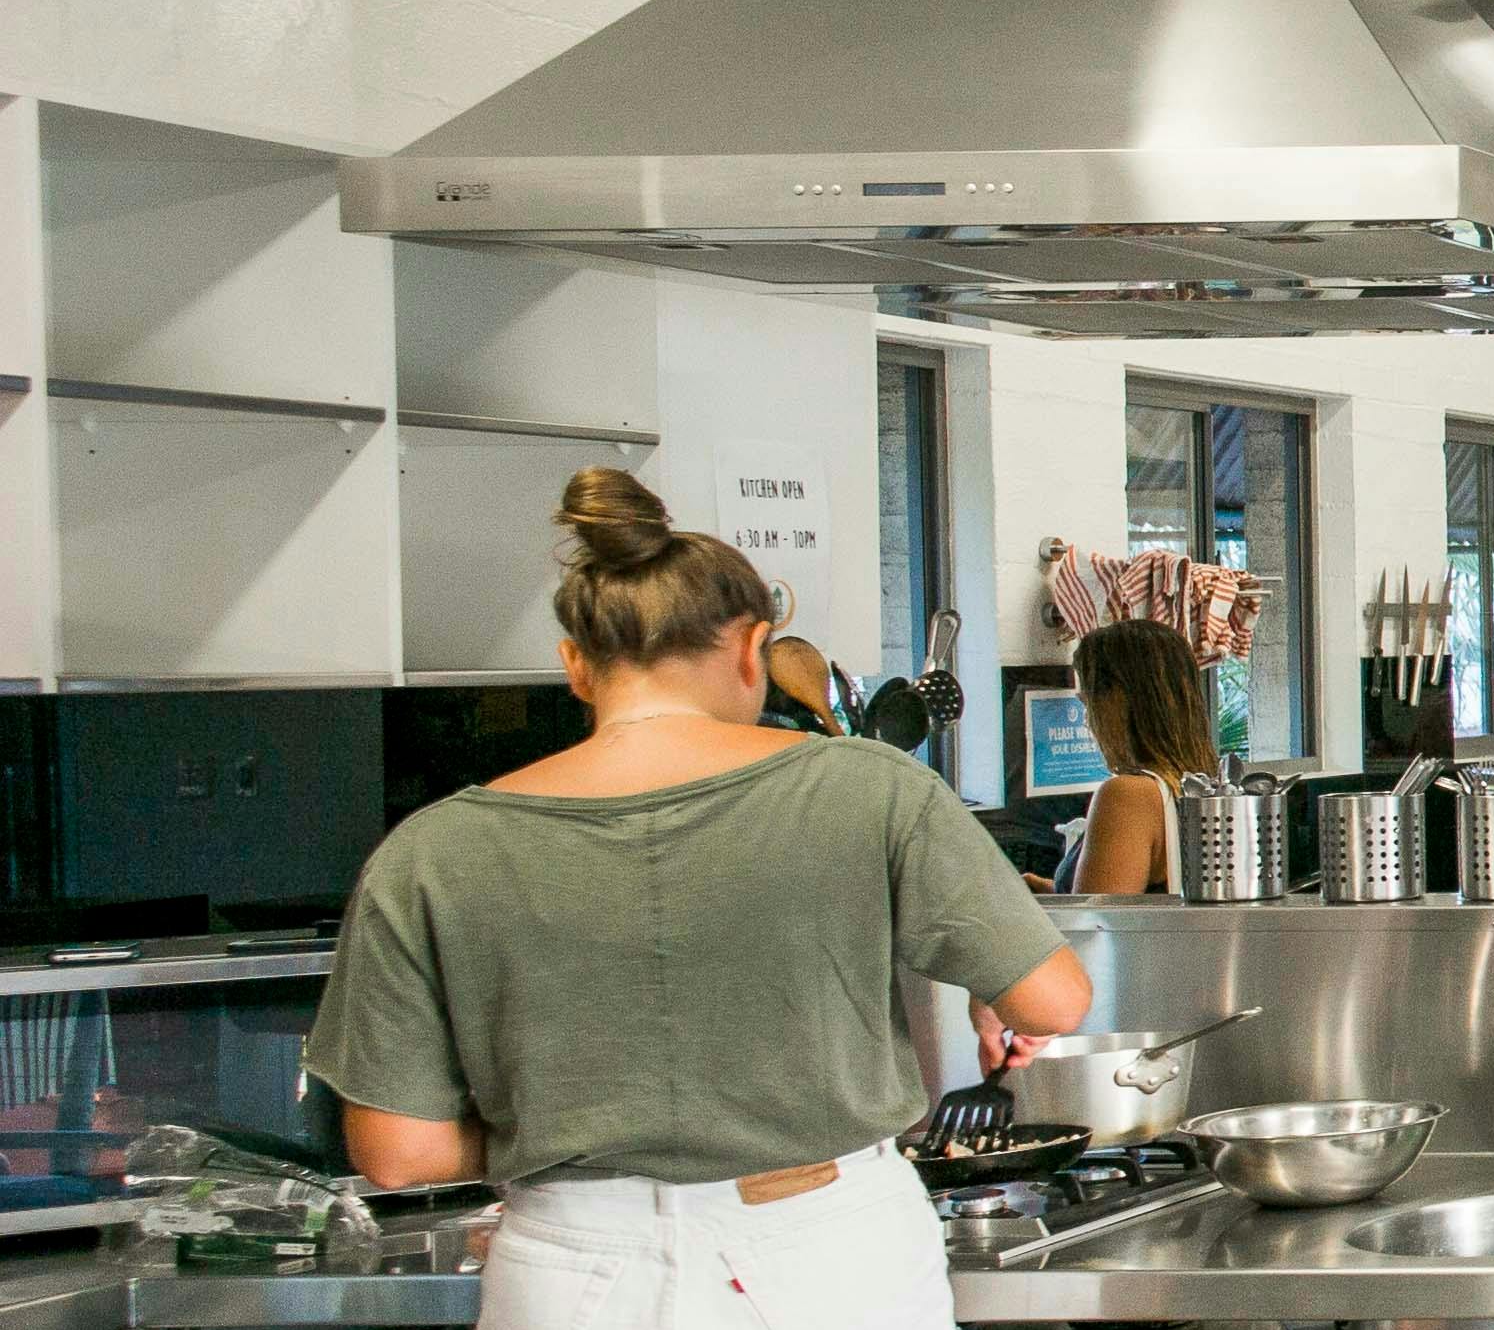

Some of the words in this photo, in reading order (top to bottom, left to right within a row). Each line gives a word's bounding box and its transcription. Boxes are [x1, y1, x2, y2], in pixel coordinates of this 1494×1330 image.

[739, 478, 778, 498] KITCHEN
[782, 480, 805, 499] OPEN
[736, 529, 760, 548] 6:30
[765, 530, 778, 549] AM
[793, 530, 816, 549] 10PM
